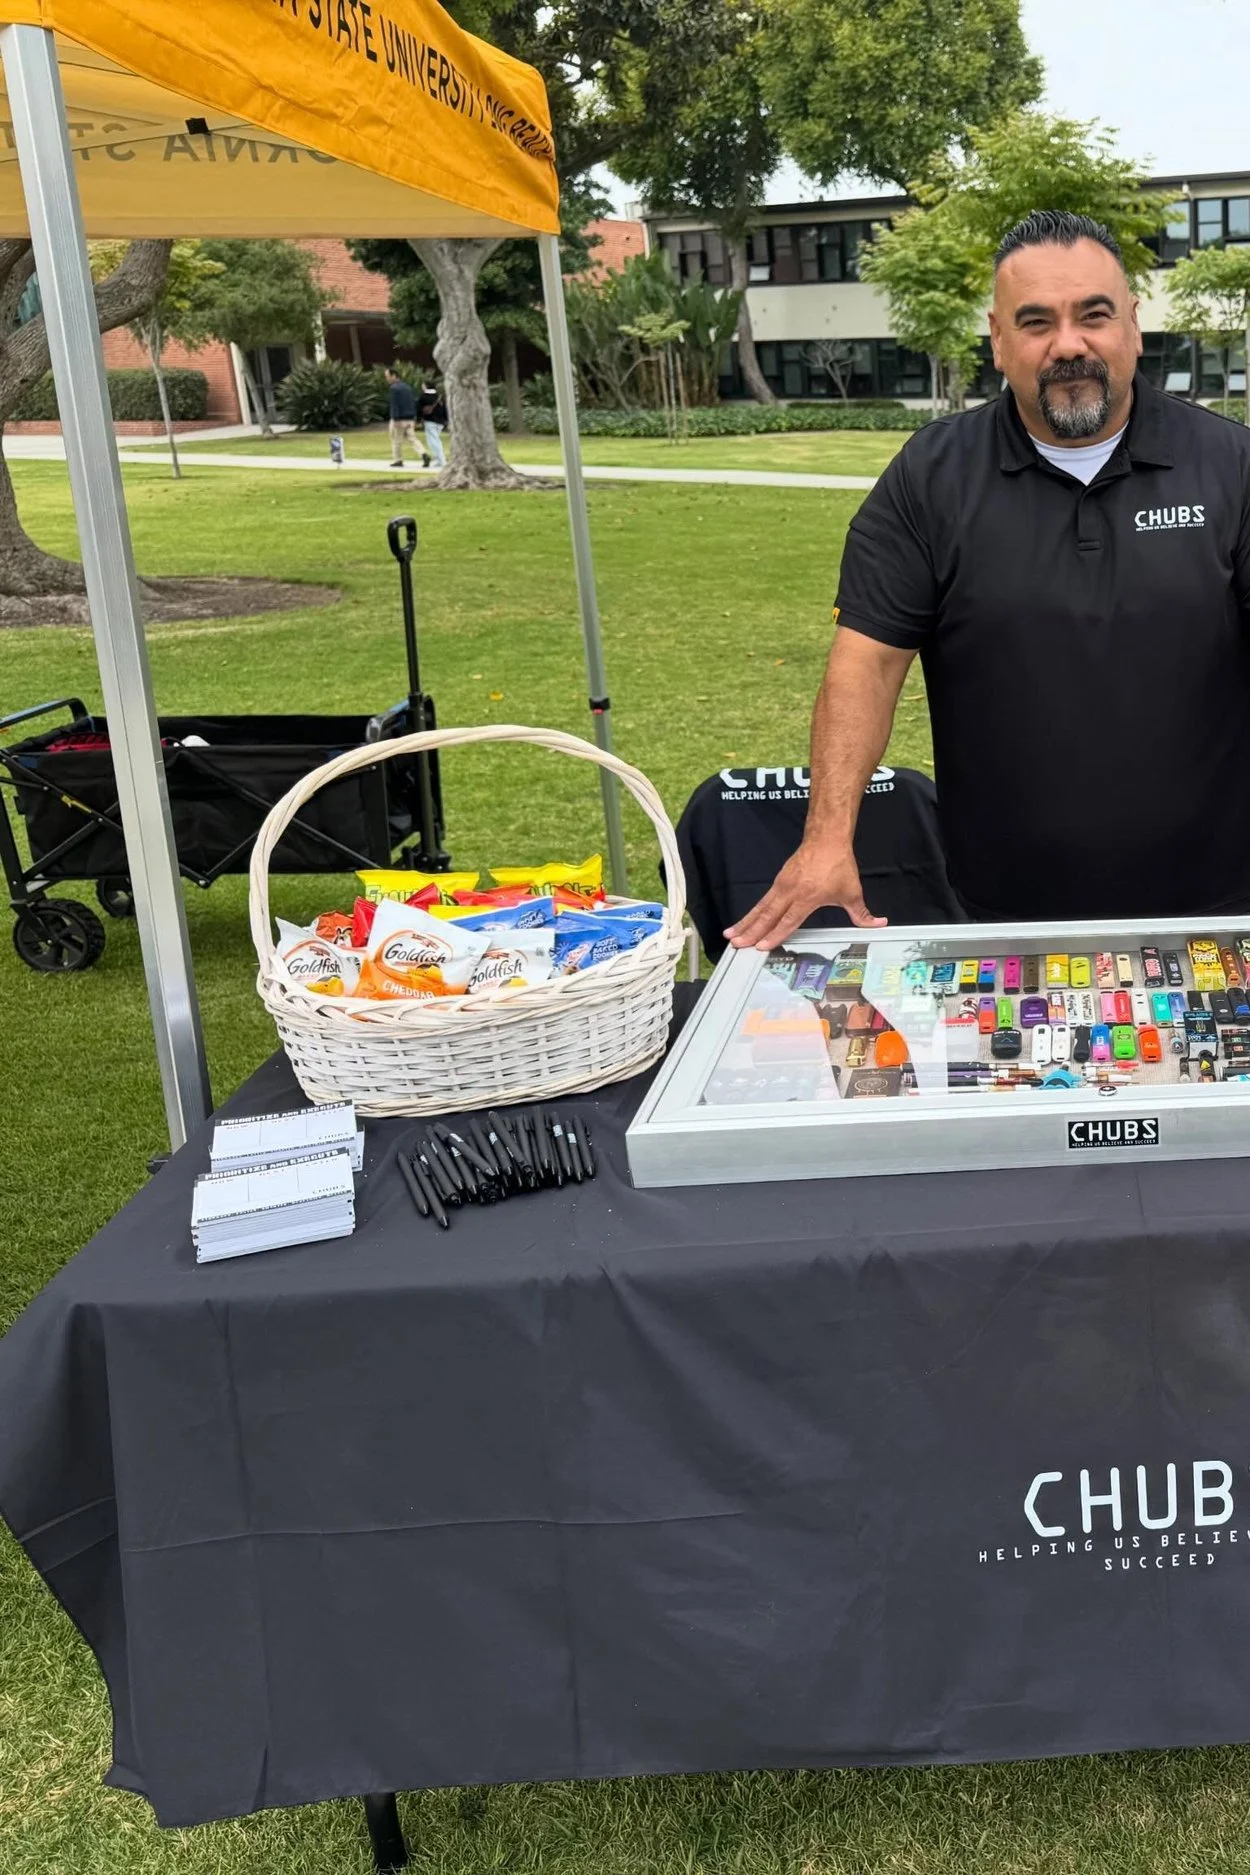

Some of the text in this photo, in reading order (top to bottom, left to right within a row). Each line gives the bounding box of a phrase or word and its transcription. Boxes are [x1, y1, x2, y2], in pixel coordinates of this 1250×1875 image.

[1134, 505, 1205, 527] CHUBS
[721, 781, 895, 800] HELPING US BELI CCEED
[385, 943, 447, 965] Goldfish
[288, 957, 342, 976] Goldfish
[1071, 1119, 1156, 1142] CHUBS
[979, 1539, 1093, 1563] HELPING
[1115, 1536, 1140, 1550] US
[1105, 1553, 1215, 1571] SUCCEED
